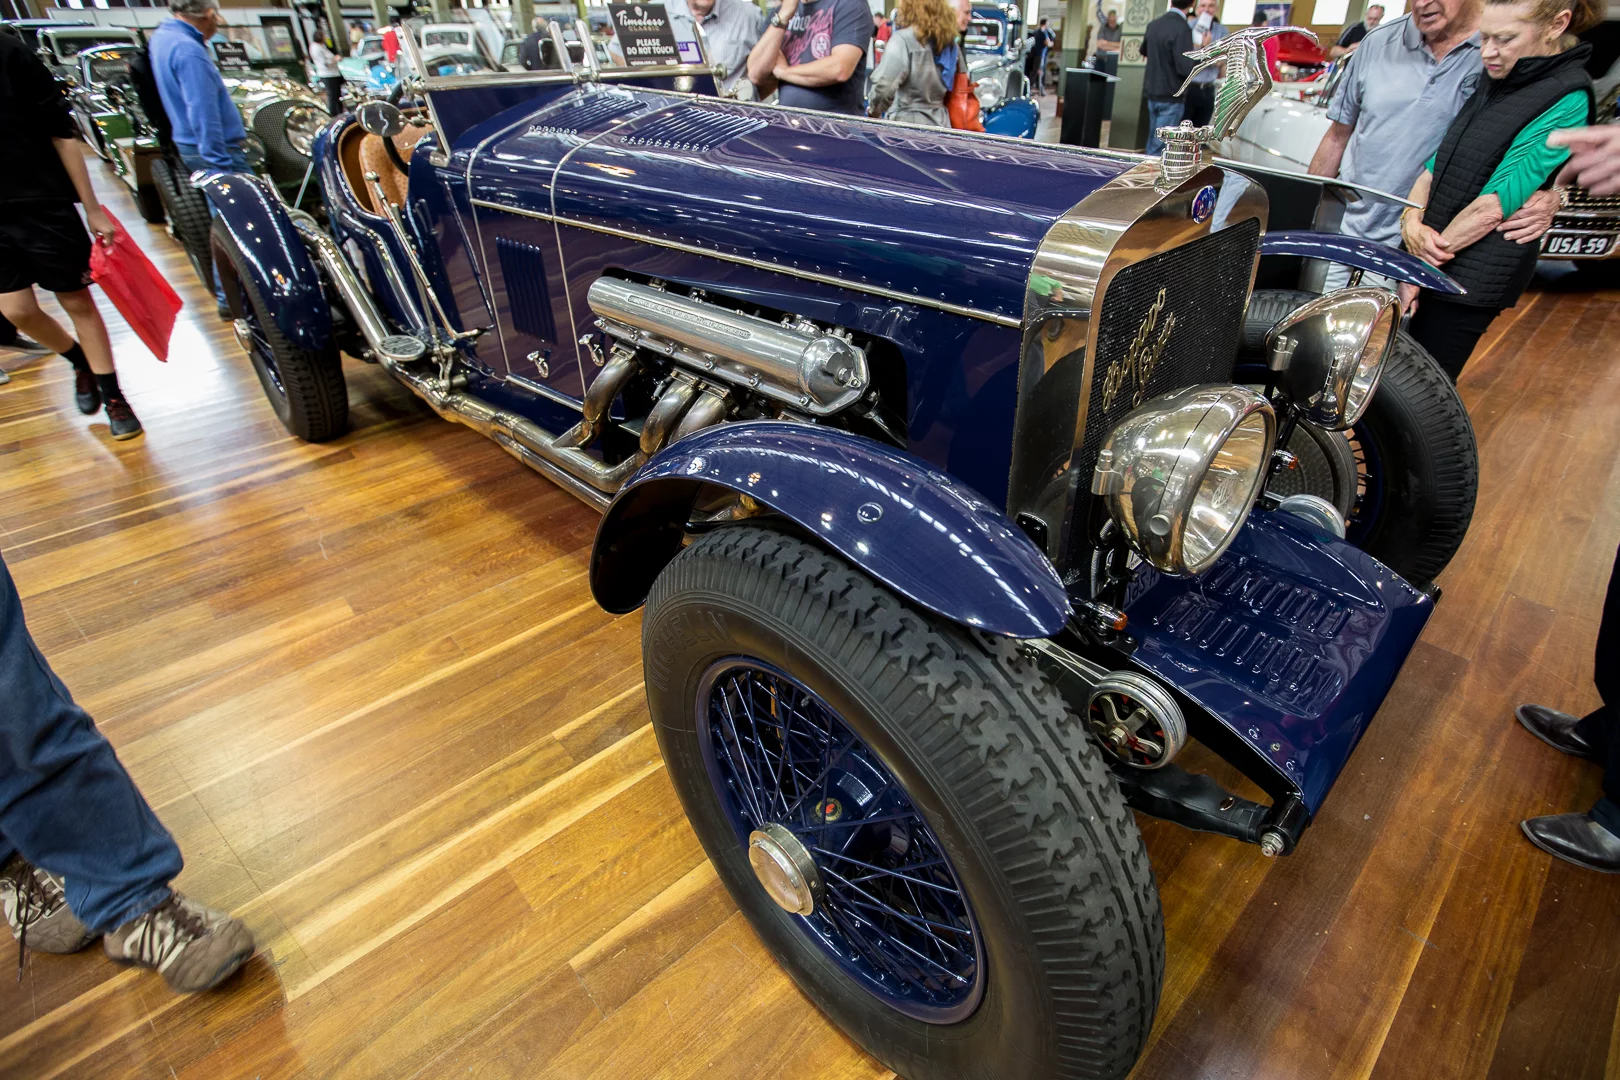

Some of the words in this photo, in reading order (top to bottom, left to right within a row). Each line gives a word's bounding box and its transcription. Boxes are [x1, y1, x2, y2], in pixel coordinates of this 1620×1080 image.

[616, 9, 665, 26] Timeless
[626, 46, 638, 56] DO
[638, 46, 652, 55] NOT
[652, 45, 675, 55] TOUCH
[636, 38, 661, 47] PLEASE
[1547, 237, 1608, 254] USA-59
[648, 609, 739, 693] MICHELIN
